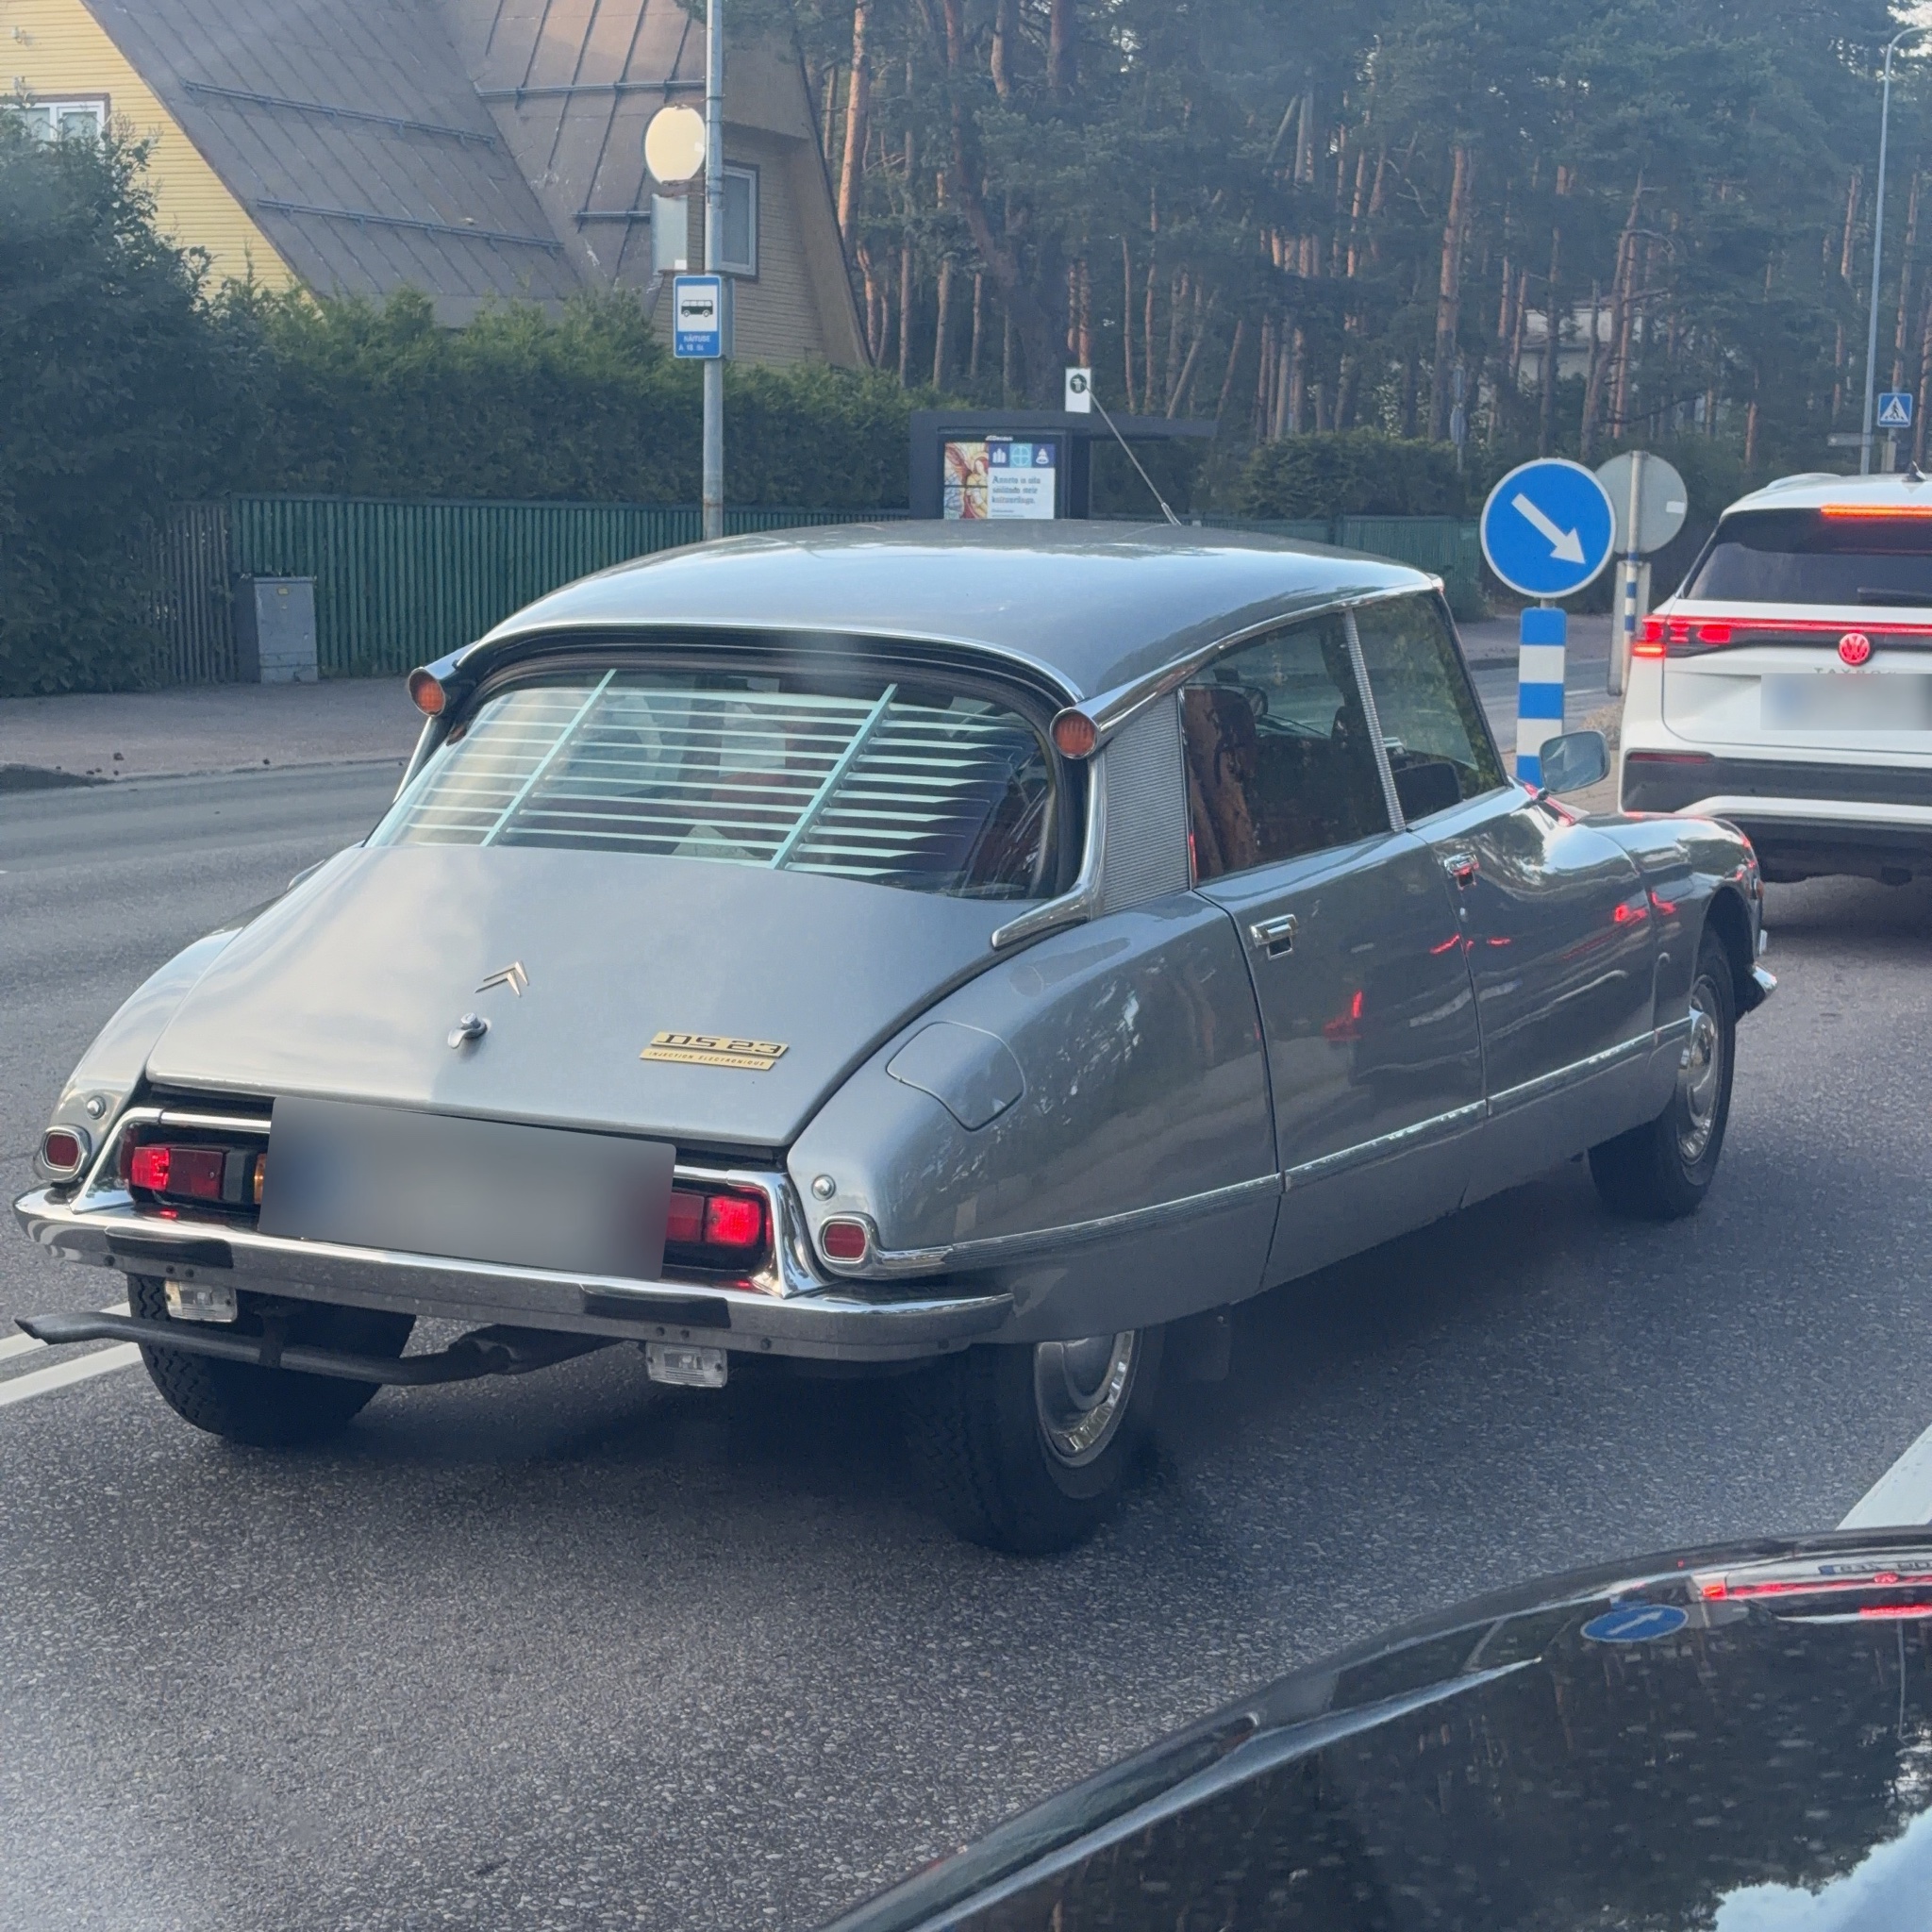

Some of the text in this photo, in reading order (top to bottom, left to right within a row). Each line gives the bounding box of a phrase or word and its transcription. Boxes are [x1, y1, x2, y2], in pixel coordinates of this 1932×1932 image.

[657, 1034, 782, 1054] DS 23
[648, 1051, 694, 1059] INJECTION
